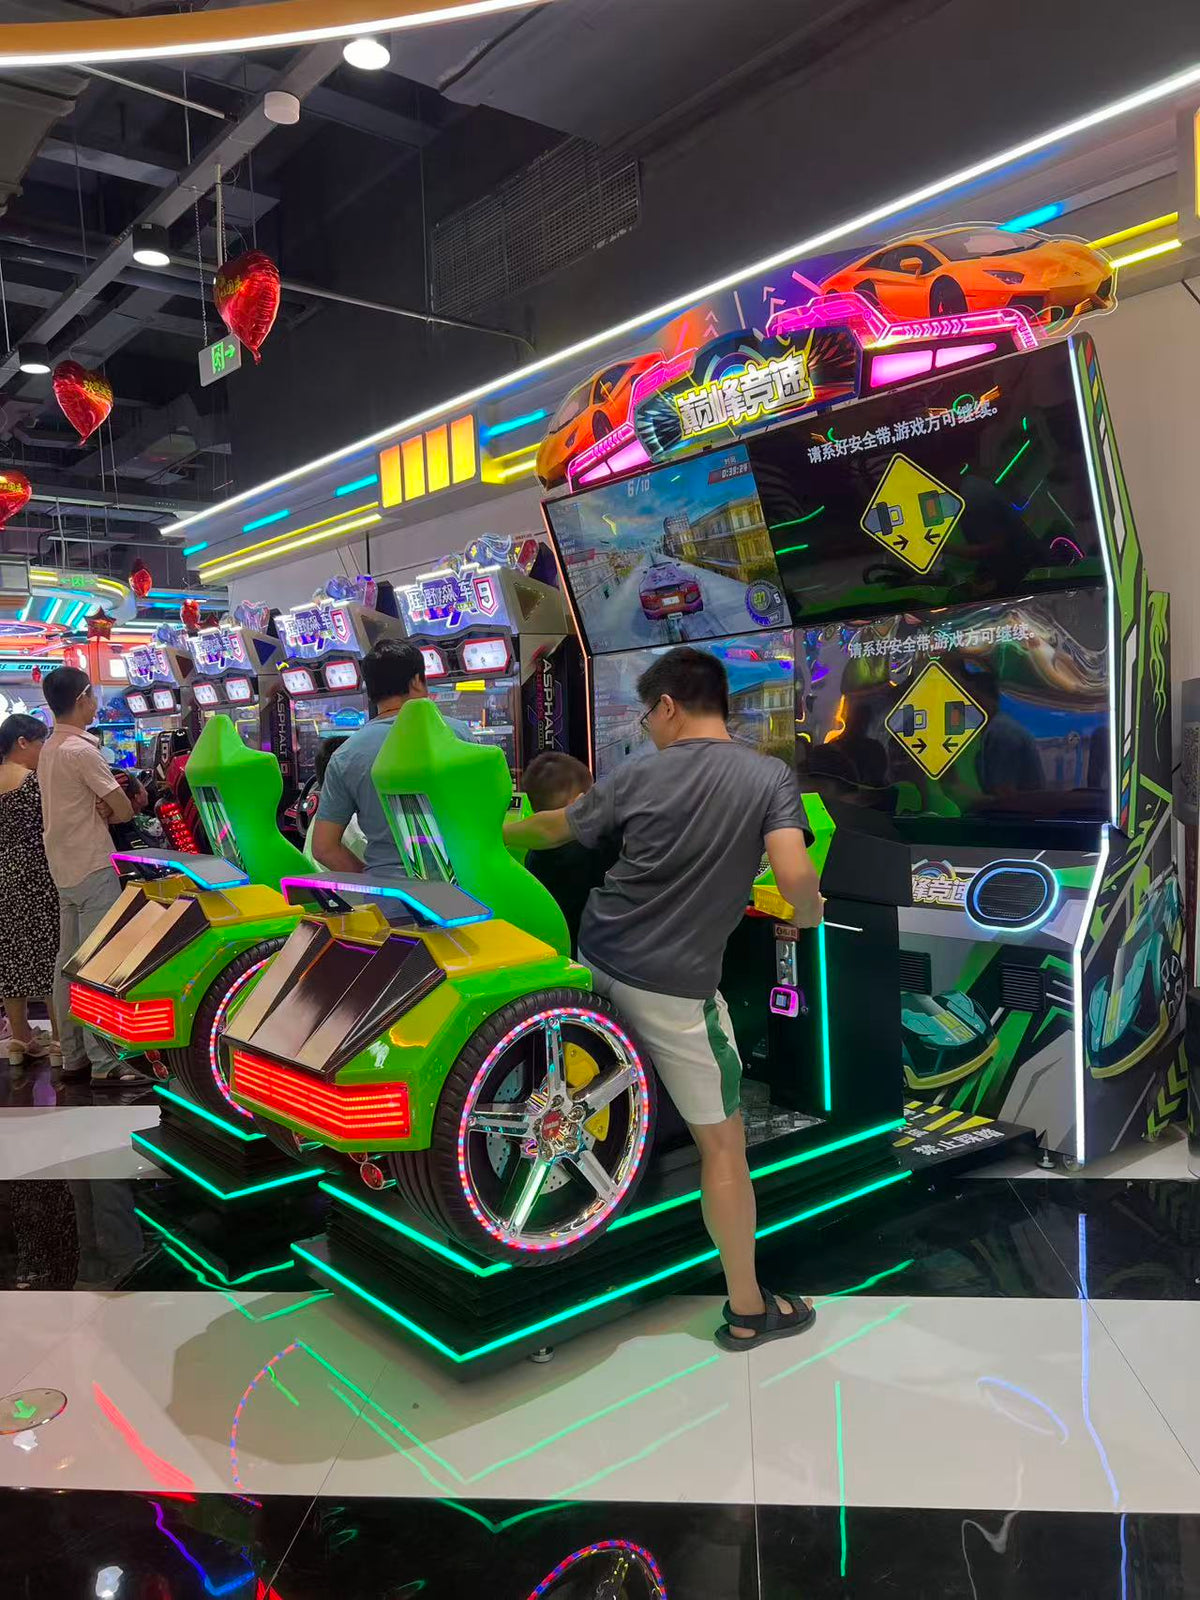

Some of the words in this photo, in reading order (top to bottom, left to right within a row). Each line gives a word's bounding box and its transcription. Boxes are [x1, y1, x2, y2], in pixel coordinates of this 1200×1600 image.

[677, 352, 813, 436] 巅峰竞速
[276, 692, 288, 759] ASPHALT
[543, 658, 555, 750] ASPHALT
